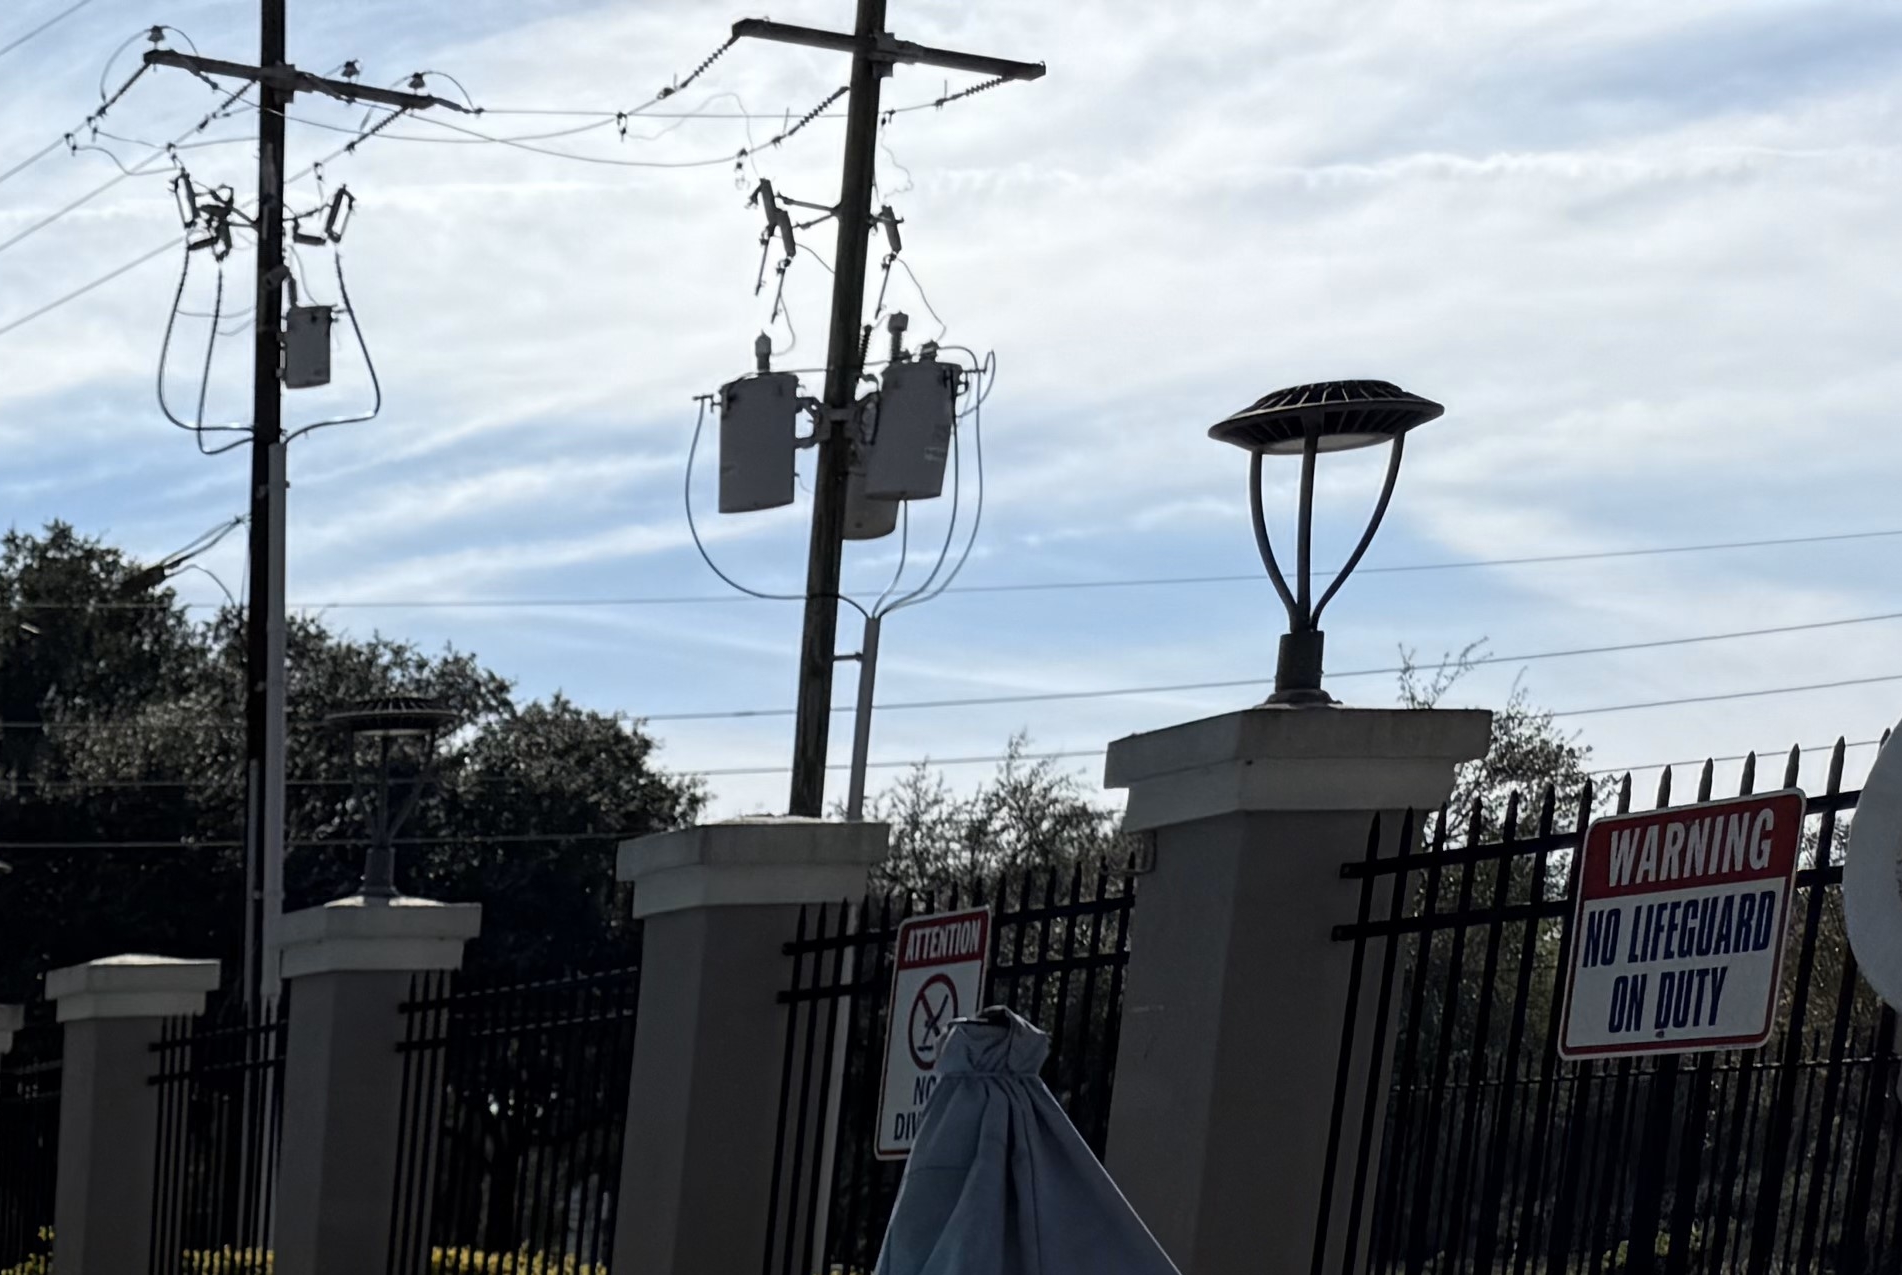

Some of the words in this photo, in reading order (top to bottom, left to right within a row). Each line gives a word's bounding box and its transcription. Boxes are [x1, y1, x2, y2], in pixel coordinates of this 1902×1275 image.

[1608, 807, 1775, 888] WARNING
[904, 918, 981, 963] ATTENTION
[1582, 907, 1621, 969] NO
[1627, 890, 1777, 964] LIFEGUARD
[1608, 973, 1647, 1034] ON
[1654, 965, 1729, 1031] DUTY
